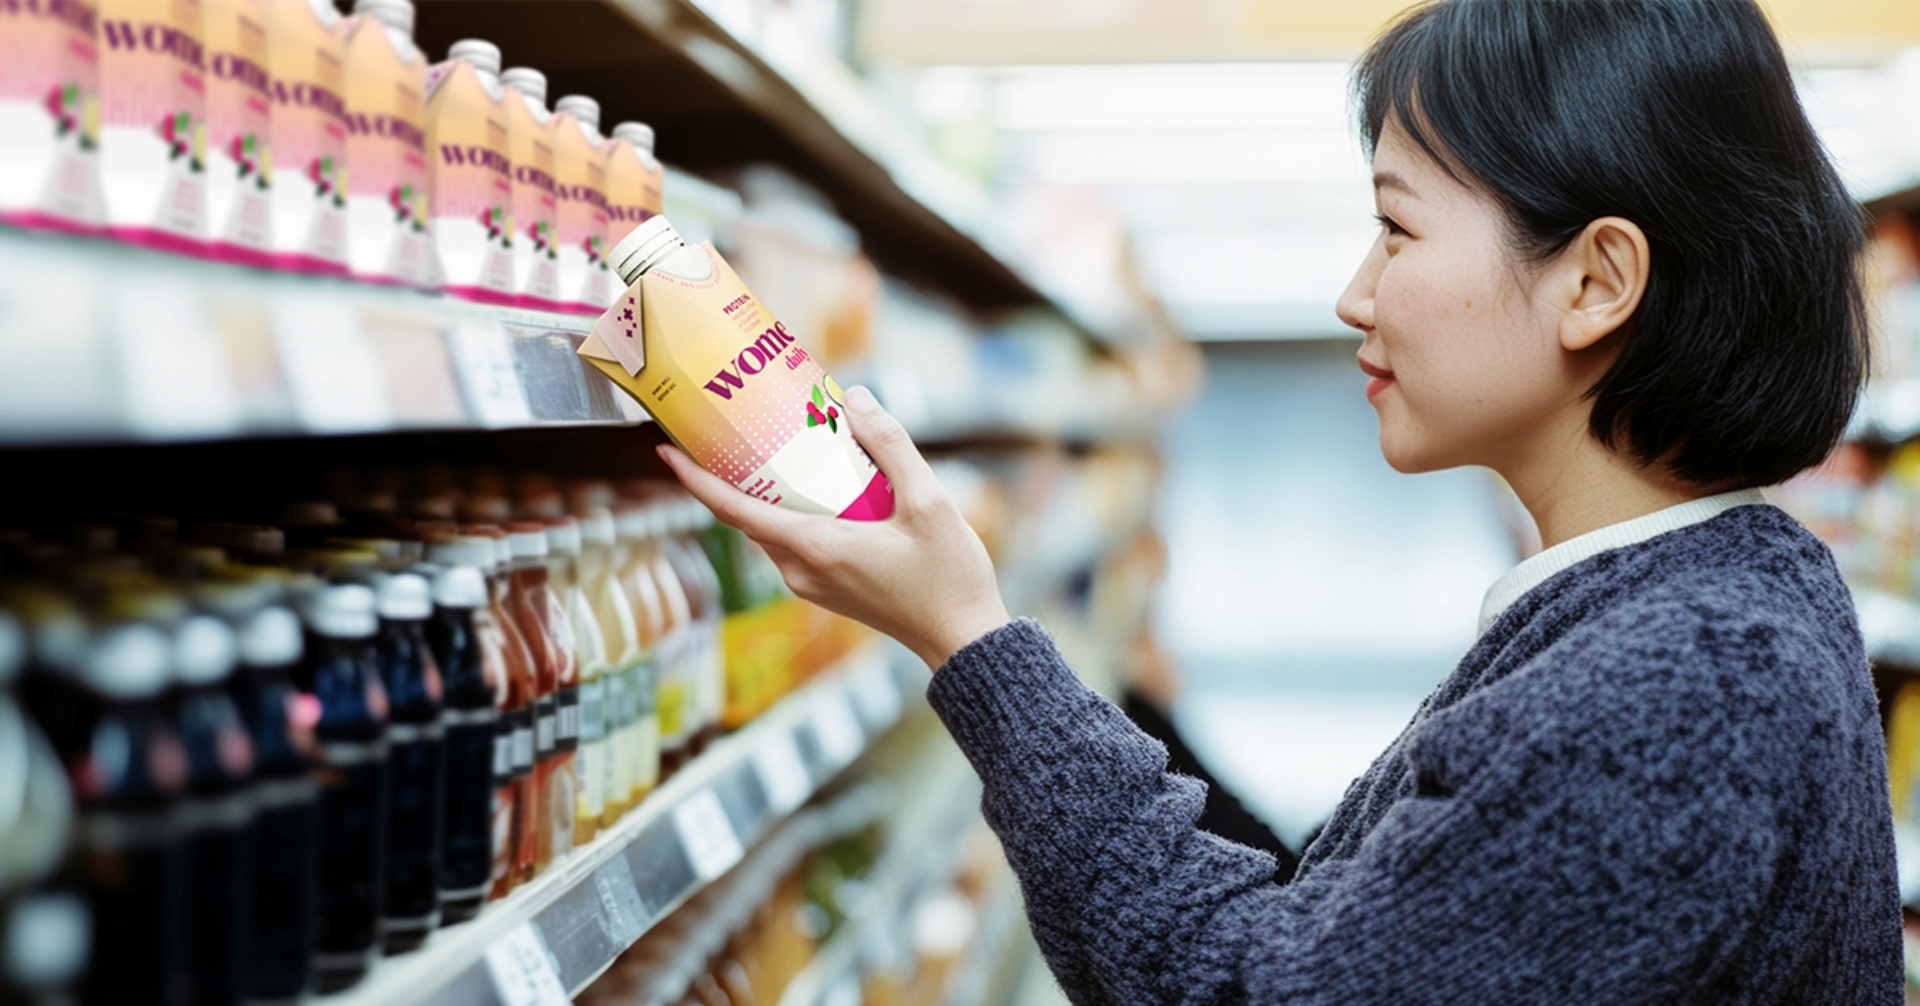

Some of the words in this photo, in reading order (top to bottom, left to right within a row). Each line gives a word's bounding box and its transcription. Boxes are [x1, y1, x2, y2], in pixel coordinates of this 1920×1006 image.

[722, 293, 751, 316] PROTEIN
[702, 320, 796, 401] wome
[785, 346, 811, 371] daily
